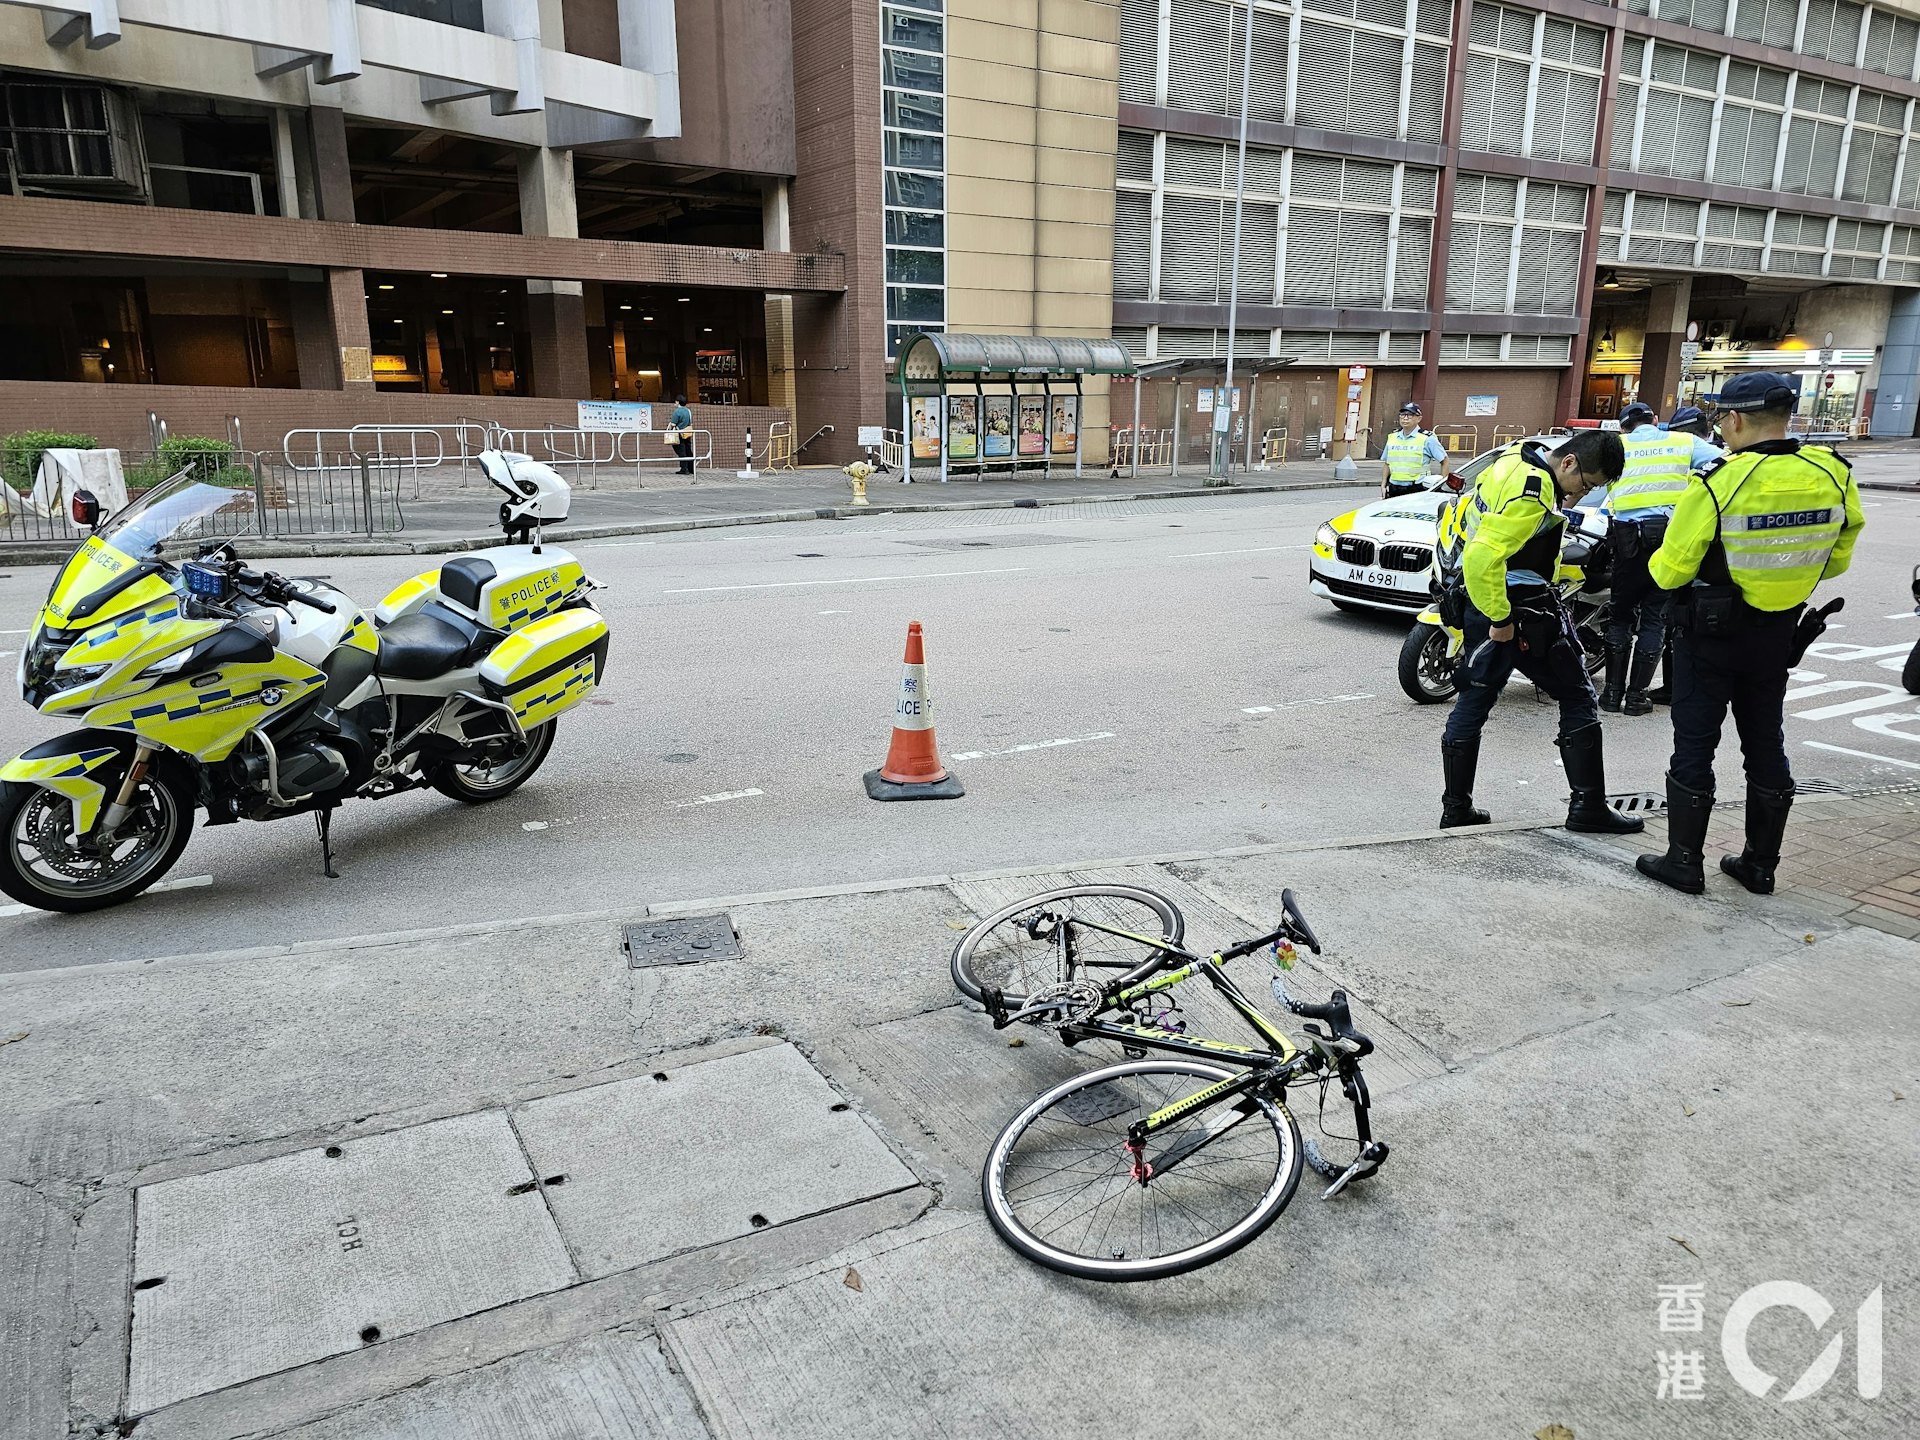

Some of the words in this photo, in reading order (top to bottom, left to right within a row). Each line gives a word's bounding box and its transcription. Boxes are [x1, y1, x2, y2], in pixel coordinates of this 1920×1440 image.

[1634, 448, 1663, 457] POLICE
[1766, 512, 1814, 529] POLICE
[1348, 568, 1364, 581] AM
[1368, 571, 1397, 587] 6981
[499, 596, 511, 610] 警
[511, 576, 551, 605] POLICE
[904, 678, 918, 693] 察
[896, 700, 921, 715] LICE
